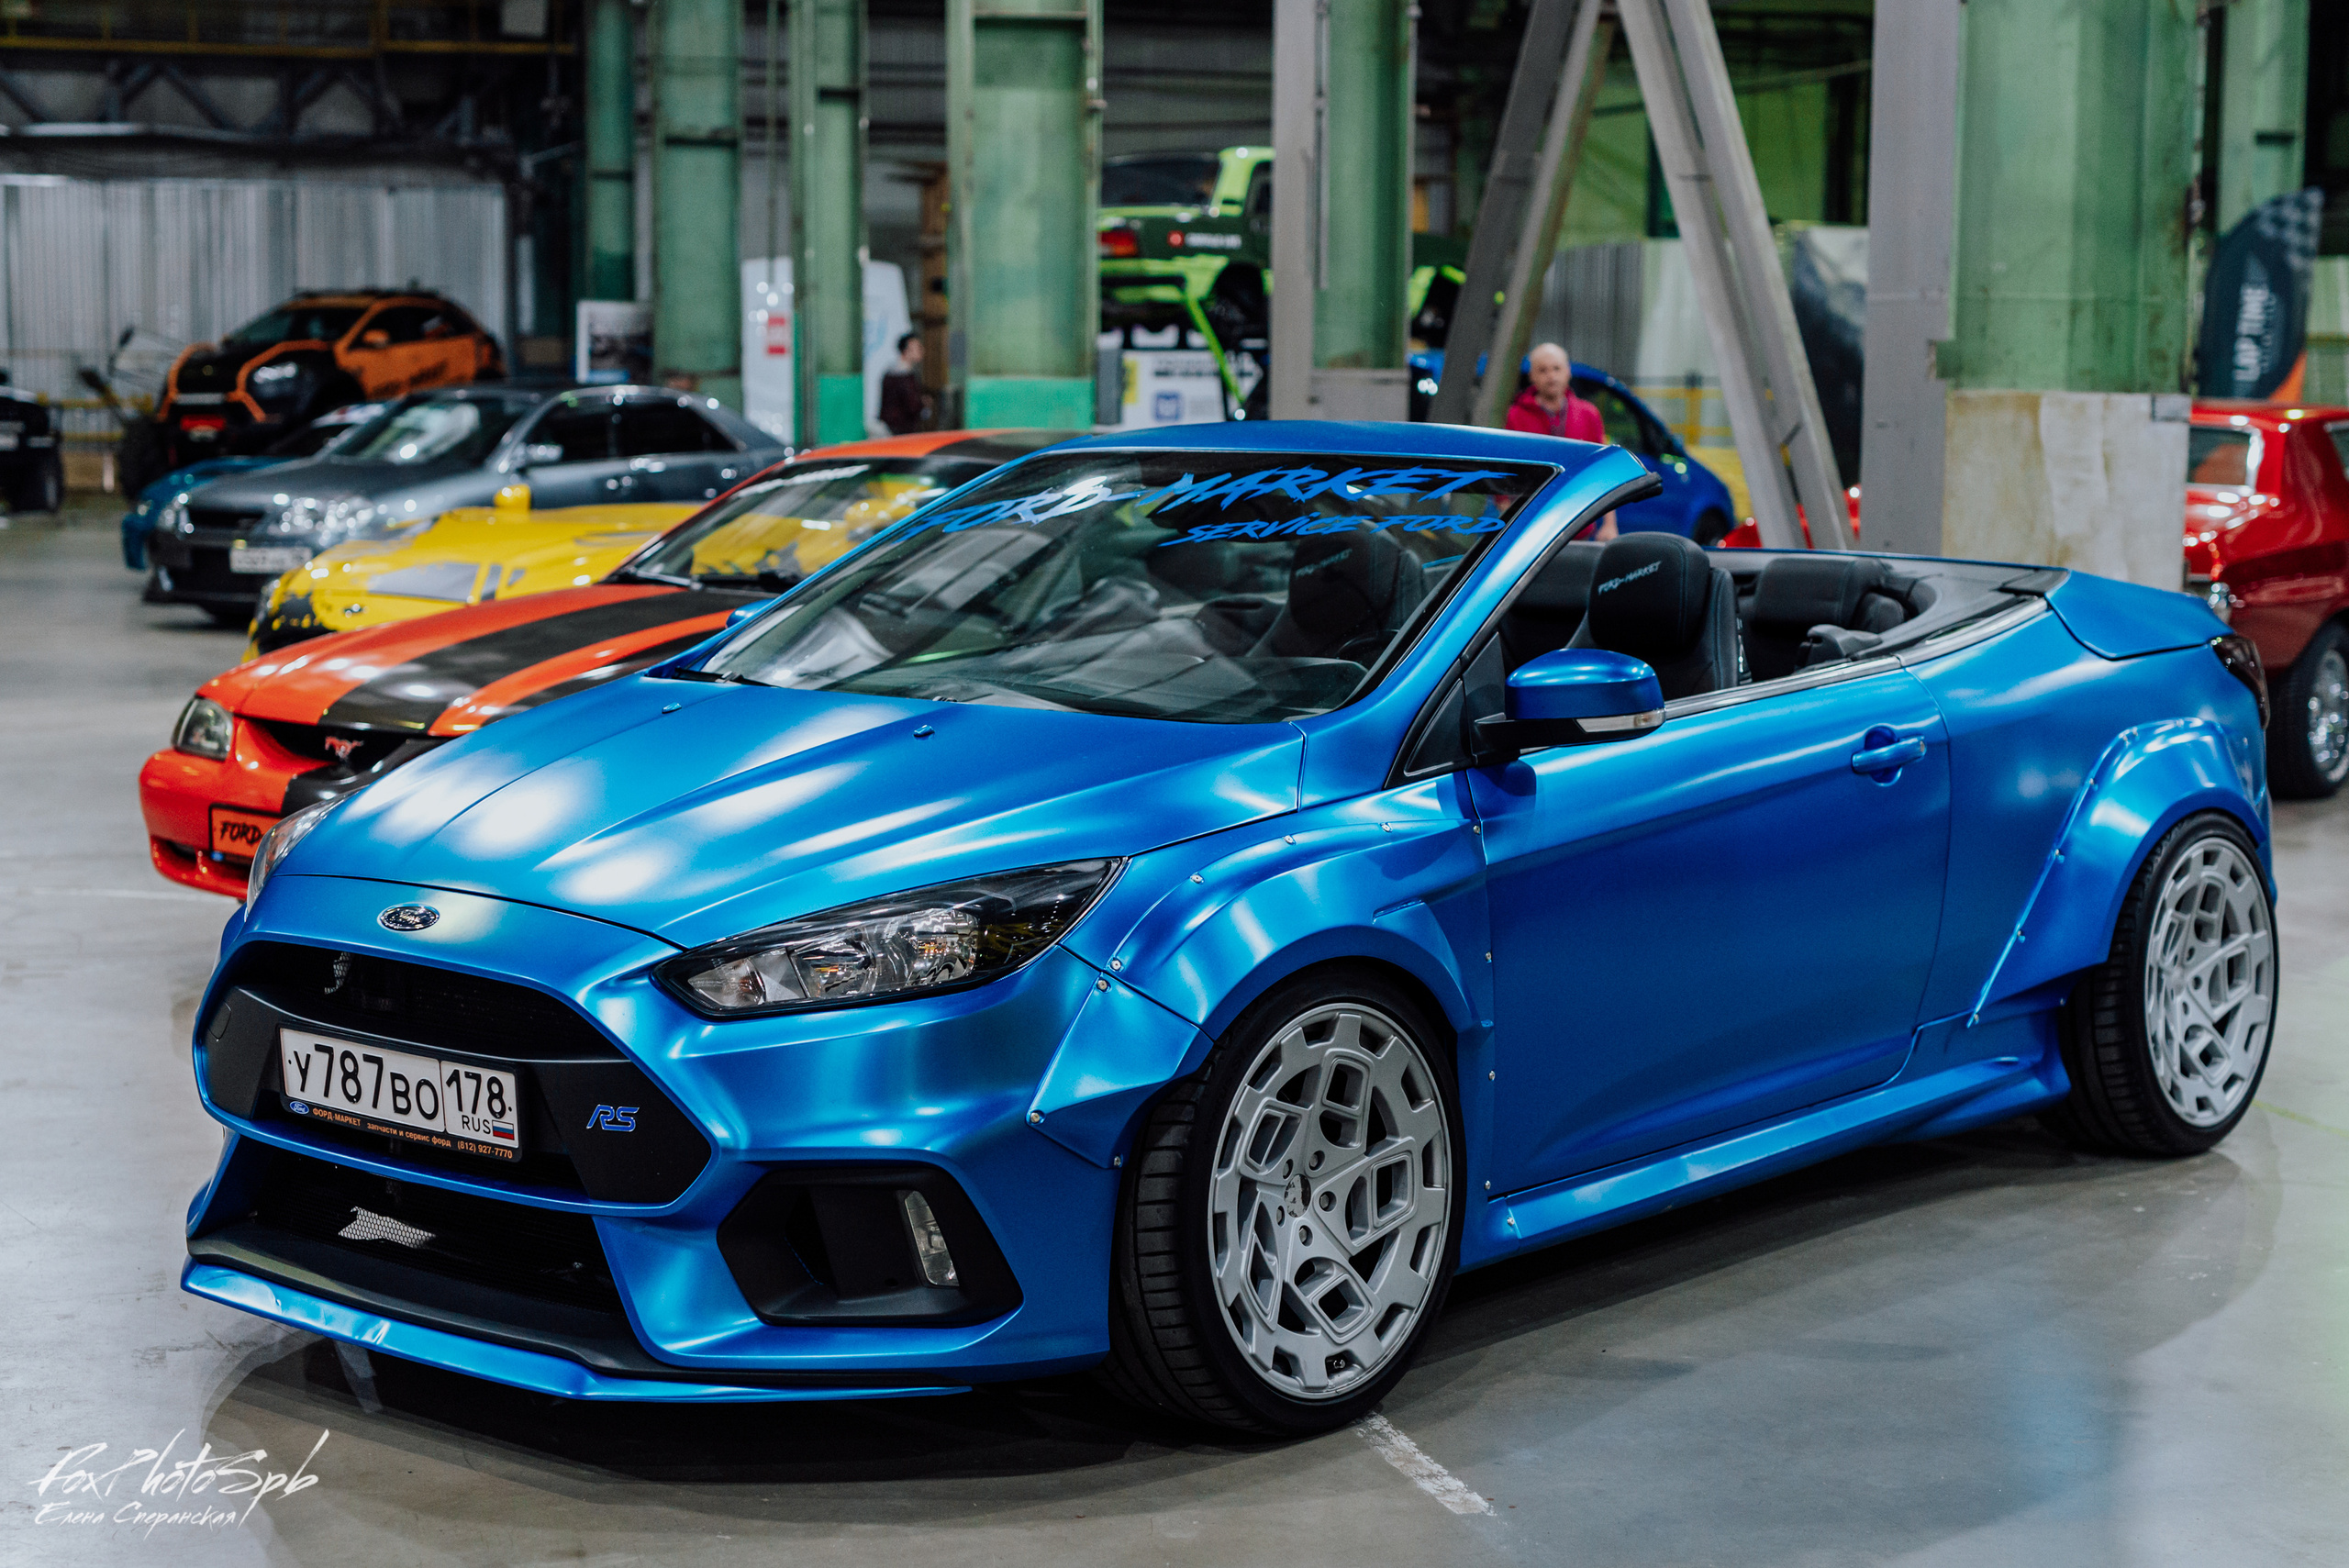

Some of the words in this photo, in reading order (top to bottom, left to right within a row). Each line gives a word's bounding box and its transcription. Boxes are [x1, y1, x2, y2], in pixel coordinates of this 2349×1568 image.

[1374, 514, 1506, 536] FORD
[462, 1115, 491, 1135] RUS
[585, 1104, 640, 1132] RS
[367, 1122, 397, 1136] запчасти
[405, 1131, 430, 1143] сервис
[457, 1140, 476, 1153] (812)
[477, 1144, 513, 1160] 927-7770
